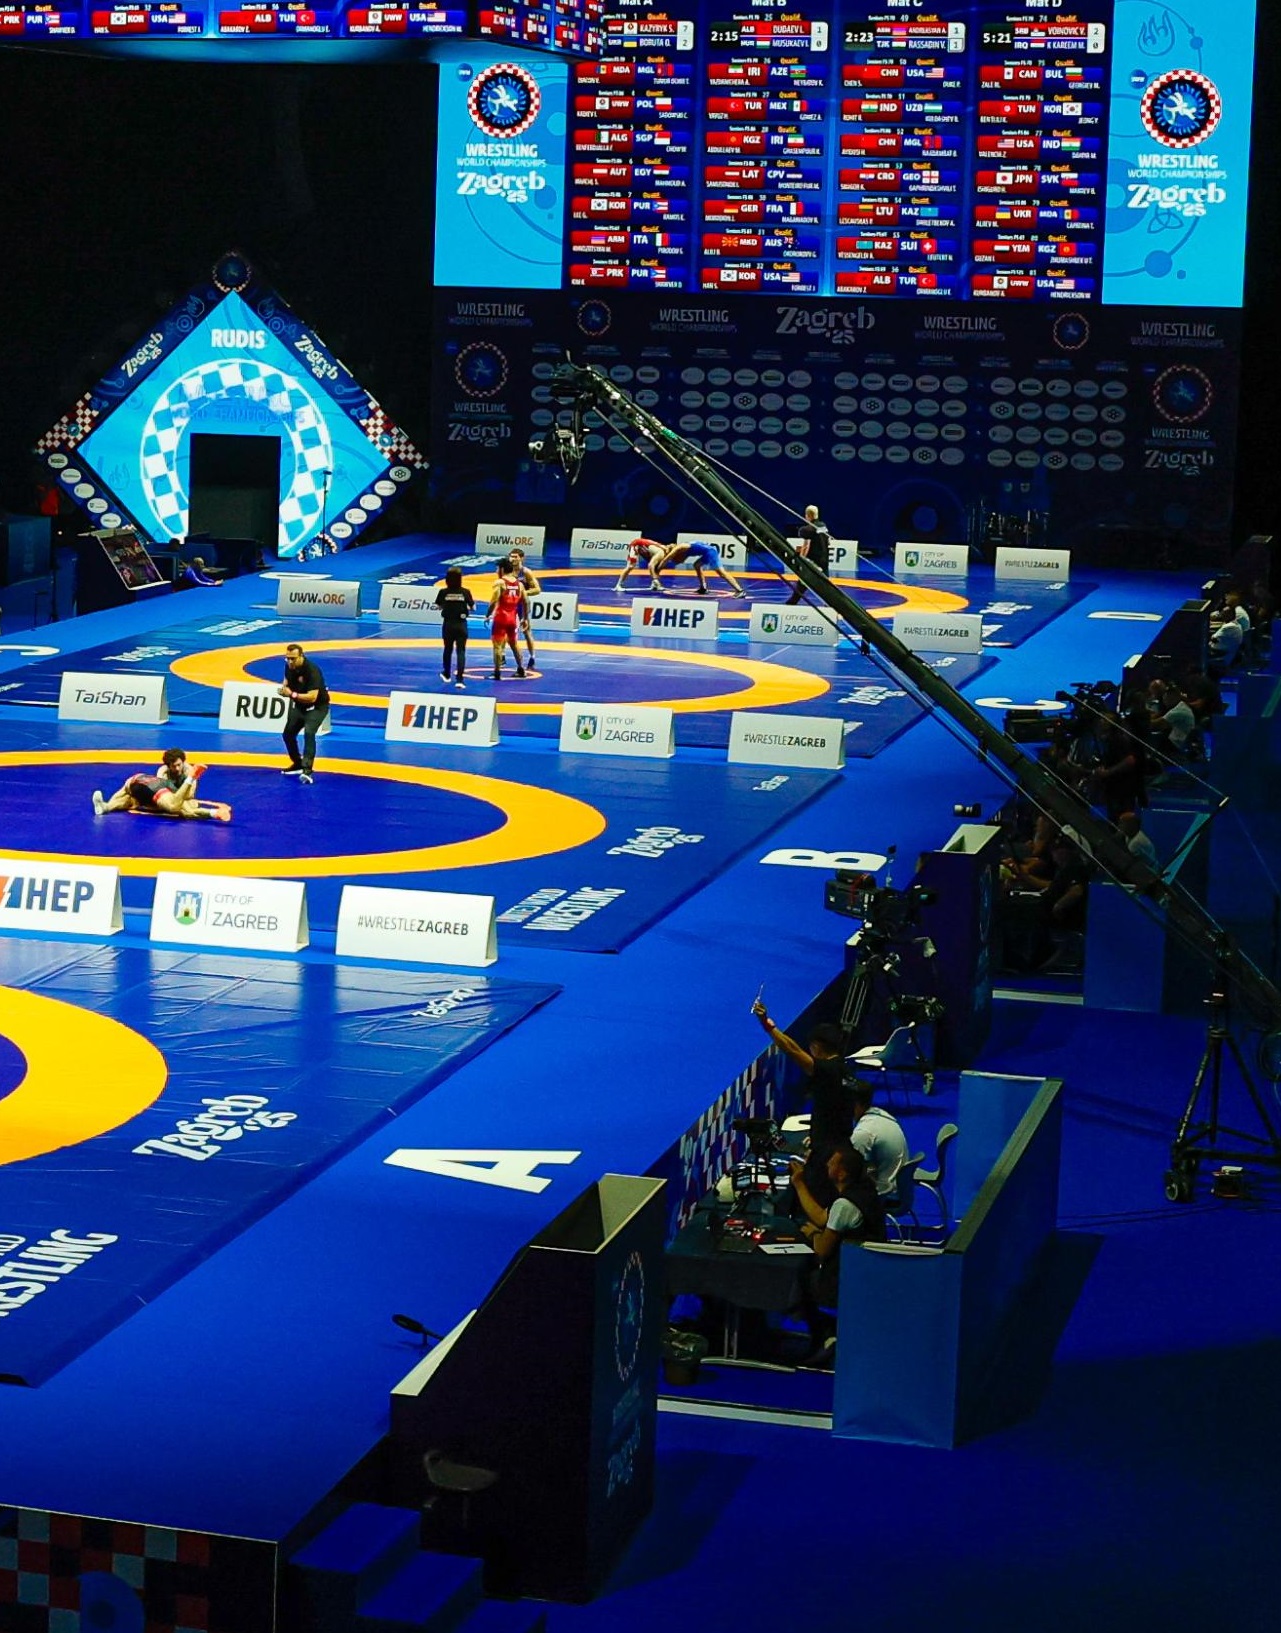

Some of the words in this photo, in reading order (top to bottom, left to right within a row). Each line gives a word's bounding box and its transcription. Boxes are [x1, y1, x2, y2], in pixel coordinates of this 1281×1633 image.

[26, 16, 42, 24] PUR
[151, 15, 168, 24] USA
[278, 14, 296, 22] TUR
[410, 14, 426, 22] USA
[710, 31, 738, 42] 2:15
[845, 32, 874, 42] 2:23
[983, 32, 1012, 44] 5:21
[612, 66, 630, 74] MDA
[638, 66, 654, 74] MGL
[748, 67, 760, 76] IRI
[770, 68, 788, 76] AZE
[880, 68, 898, 77] CHN
[906, 68, 924, 77] USA
[1018, 70, 1037, 78] CAN
[1045, 70, 1064, 78] BUL
[744, 102, 762, 110] TUR
[770, 102, 786, 110] MEX
[880, 103, 898, 112] IND
[906, 104, 923, 112] UZB
[1018, 104, 1036, 113] TUN
[1044, 105, 1062, 114] KOR
[611, 134, 628, 142] ALG
[636, 134, 653, 142] SGP
[743, 136, 760, 144] KGZ
[770, 136, 784, 144] IRI
[878, 138, 896, 146] CHN
[904, 138, 922, 146] MGL
[1016, 140, 1034, 148] USA
[1042, 140, 1060, 148] IND
[466, 143, 538, 158] WRESTLING
[457, 158, 484, 166] WORLD
[486, 158, 546, 168] CHAMPIONSHIPS
[1138, 154, 1218, 169] WRESTLING
[610, 168, 627, 176] AUT
[634, 168, 652, 176] EGY
[742, 170, 759, 178] LAT
[767, 170, 784, 178] CPV
[877, 172, 895, 180] CRO
[902, 172, 921, 181] GEO
[1128, 169, 1158, 178] WORLD
[1160, 169, 1227, 180] CHAMPIONSHIPS
[457, 170, 546, 195] Zagreb
[1014, 174, 1032, 184] JPN
[1040, 174, 1060, 184] SVK
[1127, 182, 1226, 208] Zagreb
[608, 201, 626, 210] KOR
[634, 202, 650, 210] PUR
[740, 204, 758, 212] GER
[766, 204, 783, 213] FRA
[876, 206, 893, 216] LTU
[902, 207, 919, 216] KAZ
[1013, 209, 1032, 218] UKR
[1039, 210, 1058, 218] MDA
[740, 238, 757, 246] MKD
[765, 238, 782, 246] AUS
[874, 241, 892, 250] KAZ
[900, 242, 918, 250] SUI
[1012, 244, 1030, 253] YEM
[1038, 244, 1056, 254] KGZ
[606, 268, 624, 277] PRK
[631, 268, 648, 277] PUR
[738, 272, 756, 280] KOR
[764, 272, 780, 281] USA
[873, 276, 891, 284] ALB
[899, 276, 916, 284] TUR
[457, 302, 524, 317] WRESTLING
[659, 309, 729, 323] WRESTLING
[776, 305, 876, 336] Zagreb
[924, 316, 998, 331] WRESTLING
[1141, 322, 1215, 338] WRESTLING
[211, 329, 266, 350] RUDIS
[120, 332, 164, 378] Zagreb
[294, 334, 339, 381] Zagreb
[486, 534, 534, 546] UWW.ORG
[924, 559, 958, 569] ZAGREB
[289, 592, 345, 606] UWW.ORG
[392, 598, 441, 610] TaiSha
[531, 602, 562, 620] DIS
[663, 607, 704, 629] HEP
[784, 624, 824, 636] ZAGREB
[903, 626, 970, 638] #WRESTLEZAGREB
[74, 689, 146, 706] TaiShan
[236, 694, 286, 720] RUD
[428, 706, 478, 732] HEP
[606, 717, 623, 725] CITY
[626, 718, 636, 726] OF
[605, 728, 655, 744] ZAGREB
[744, 734, 826, 748] #WRESTLEZAGREB
[759, 848, 888, 872] B
[25, 878, 94, 914] HEP
[214, 894, 236, 904] CITY
[239, 896, 253, 905] OF
[212, 910, 278, 932] ZAGREB
[357, 915, 470, 937] #WRESTLEZAGREB
[132, 1093, 270, 1161] Zagreb
[384, 1148, 582, 1194] A
